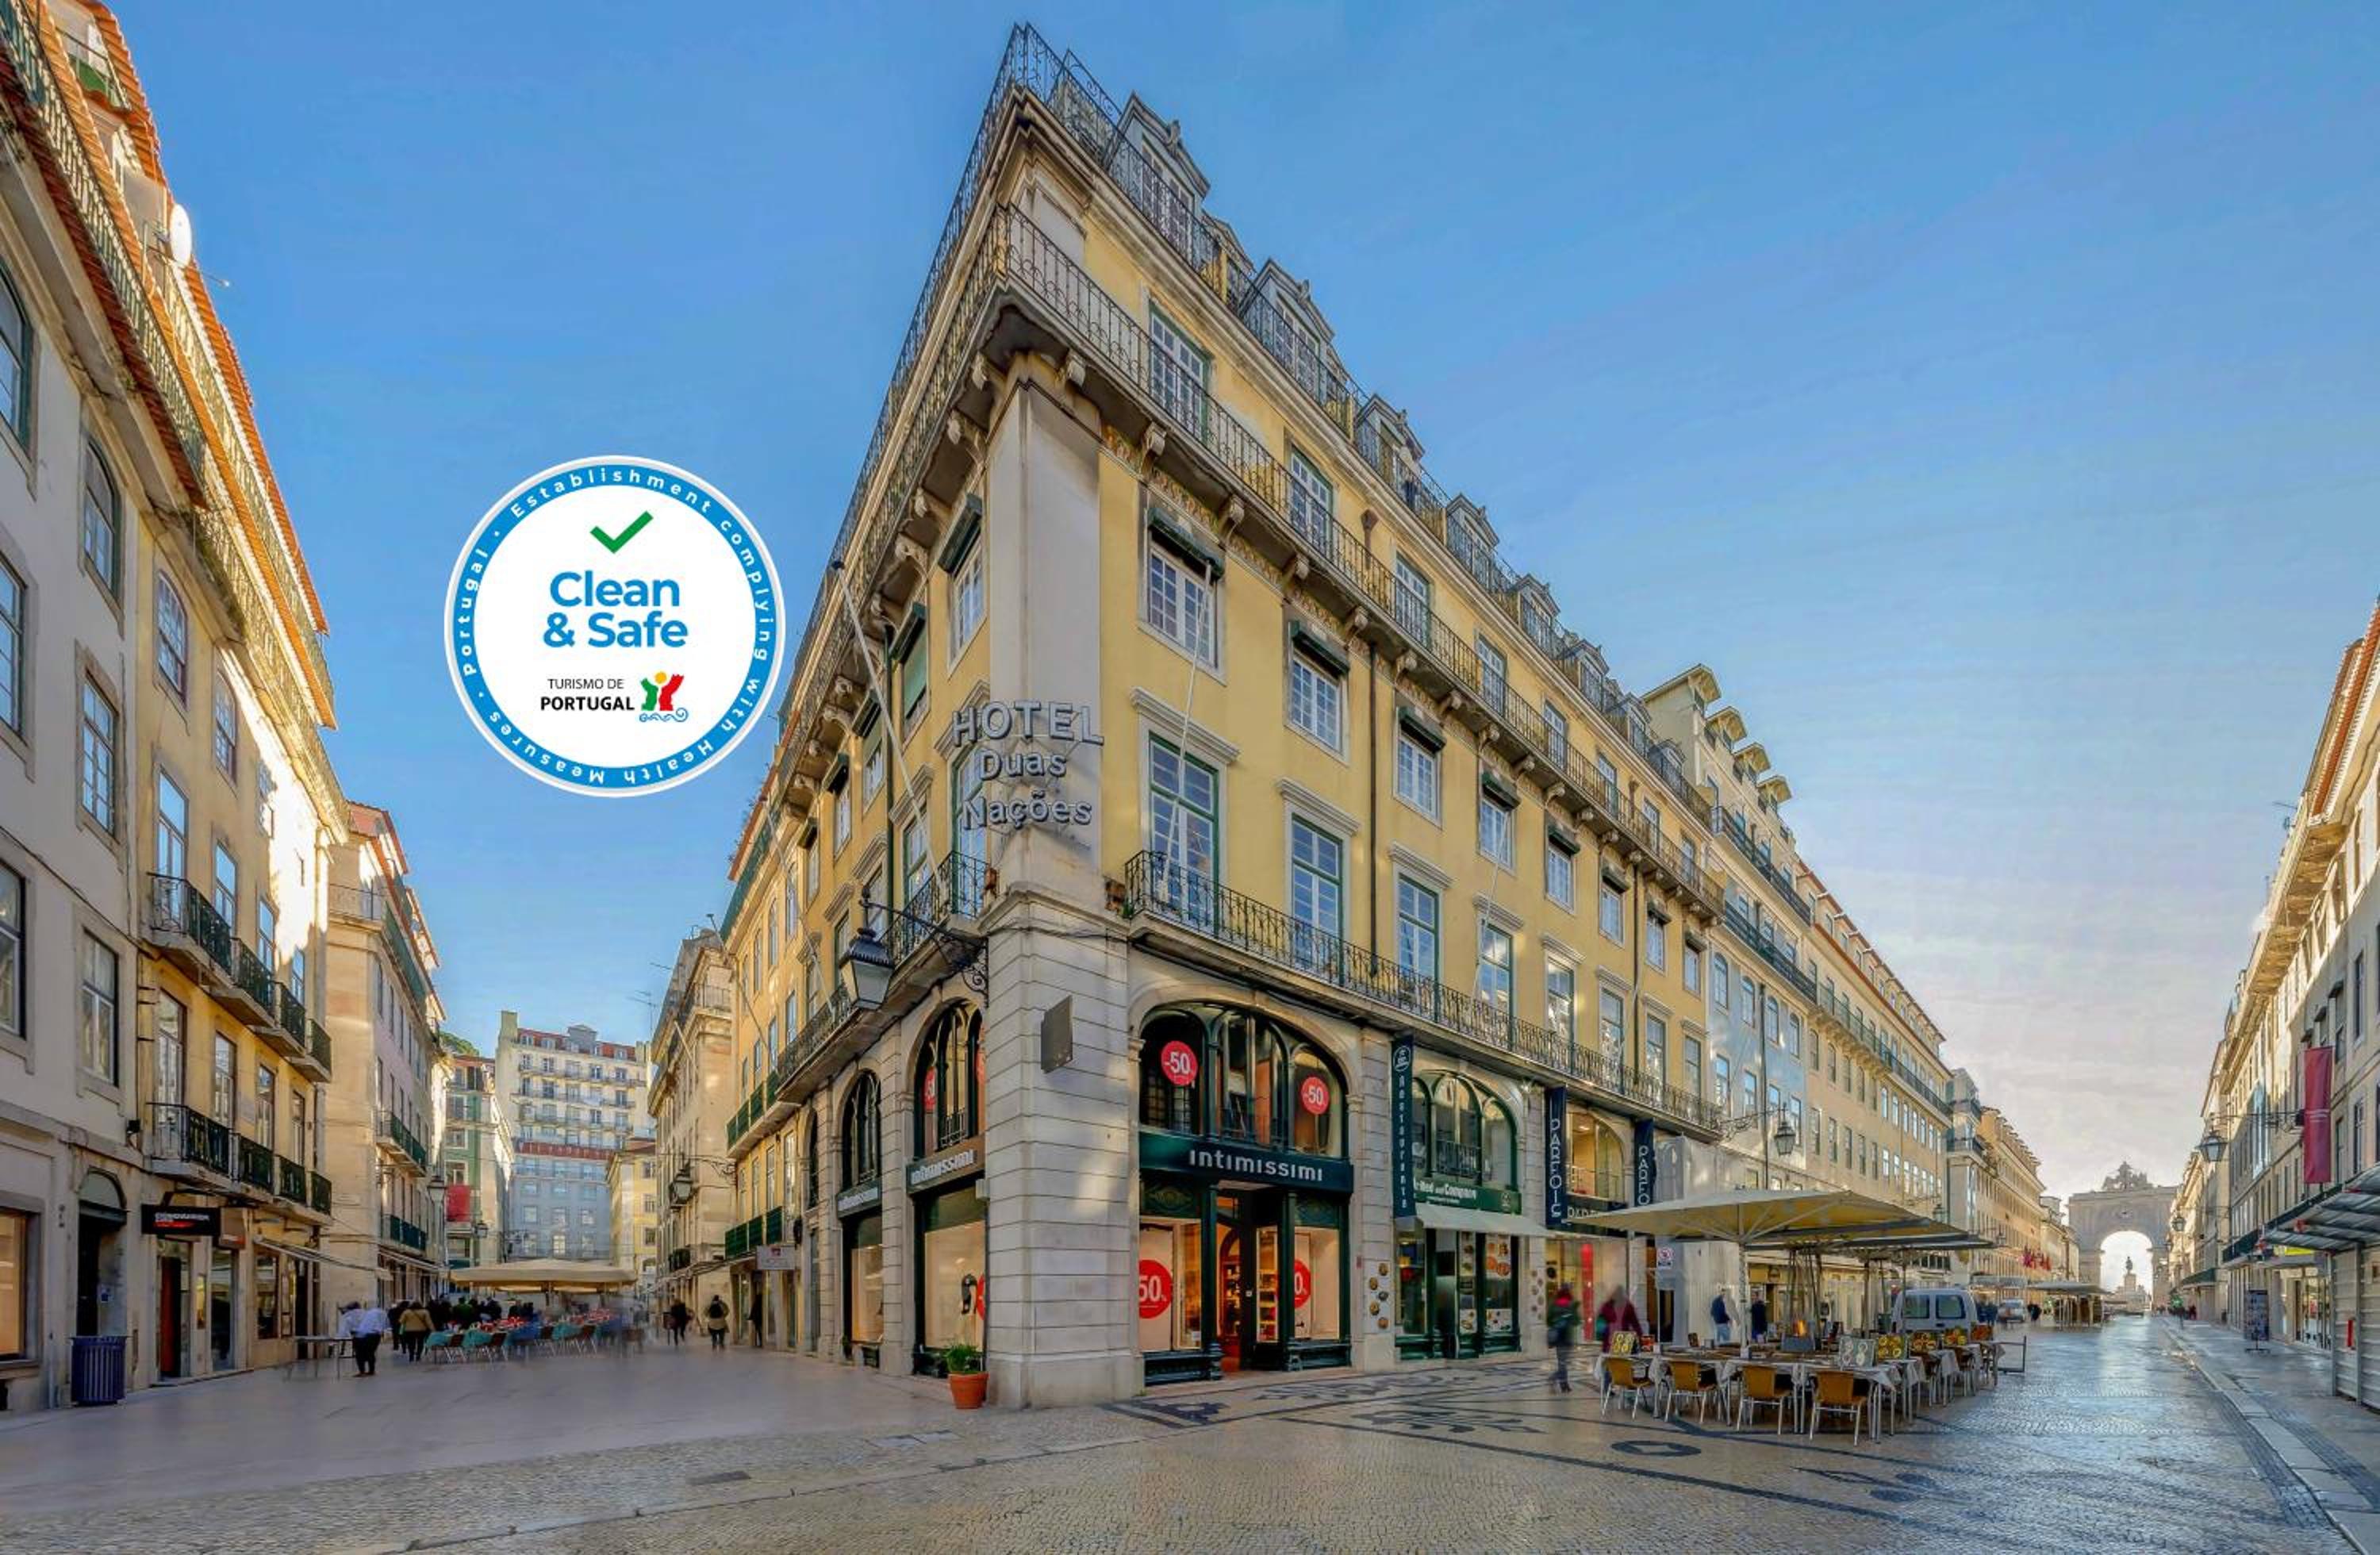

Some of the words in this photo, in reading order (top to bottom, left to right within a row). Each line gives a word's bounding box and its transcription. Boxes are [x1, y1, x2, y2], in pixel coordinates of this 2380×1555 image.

[952, 701, 1104, 747] HOTEL
[980, 749, 1068, 781] Duas
[963, 790, 1092, 831] Nações
[1637, 1145, 1650, 1205] PARFO
